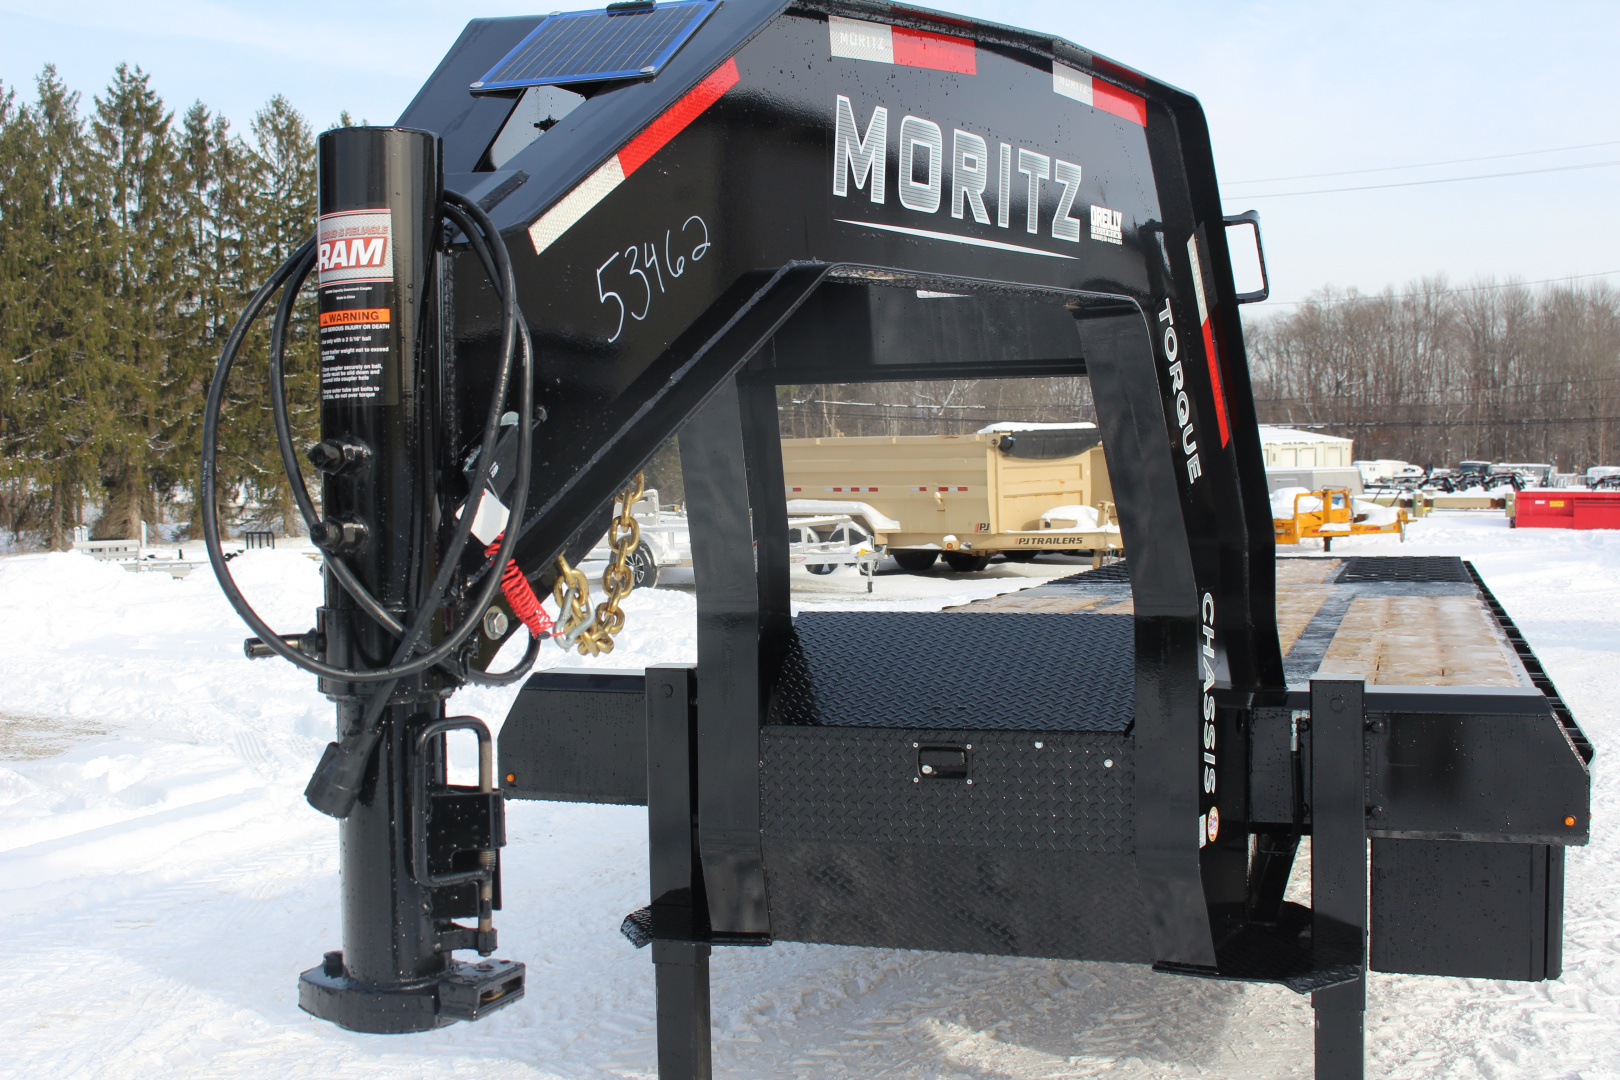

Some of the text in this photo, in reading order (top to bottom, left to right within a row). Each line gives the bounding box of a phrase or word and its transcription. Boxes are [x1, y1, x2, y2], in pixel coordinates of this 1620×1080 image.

[840, 31, 884, 49] MORITZ
[833, 94, 1082, 242] MORITZ
[320, 238, 385, 271] RAM
[597, 215, 711, 343] 53462
[1191, 250, 1204, 311] MORITZ
[328, 312, 379, 323] WARNING
[979, 522, 990, 531] PJ
[1018, 536, 1083, 545] PJ TRAILERS
[1158, 297, 1216, 794] TORQUE CHASSIS
